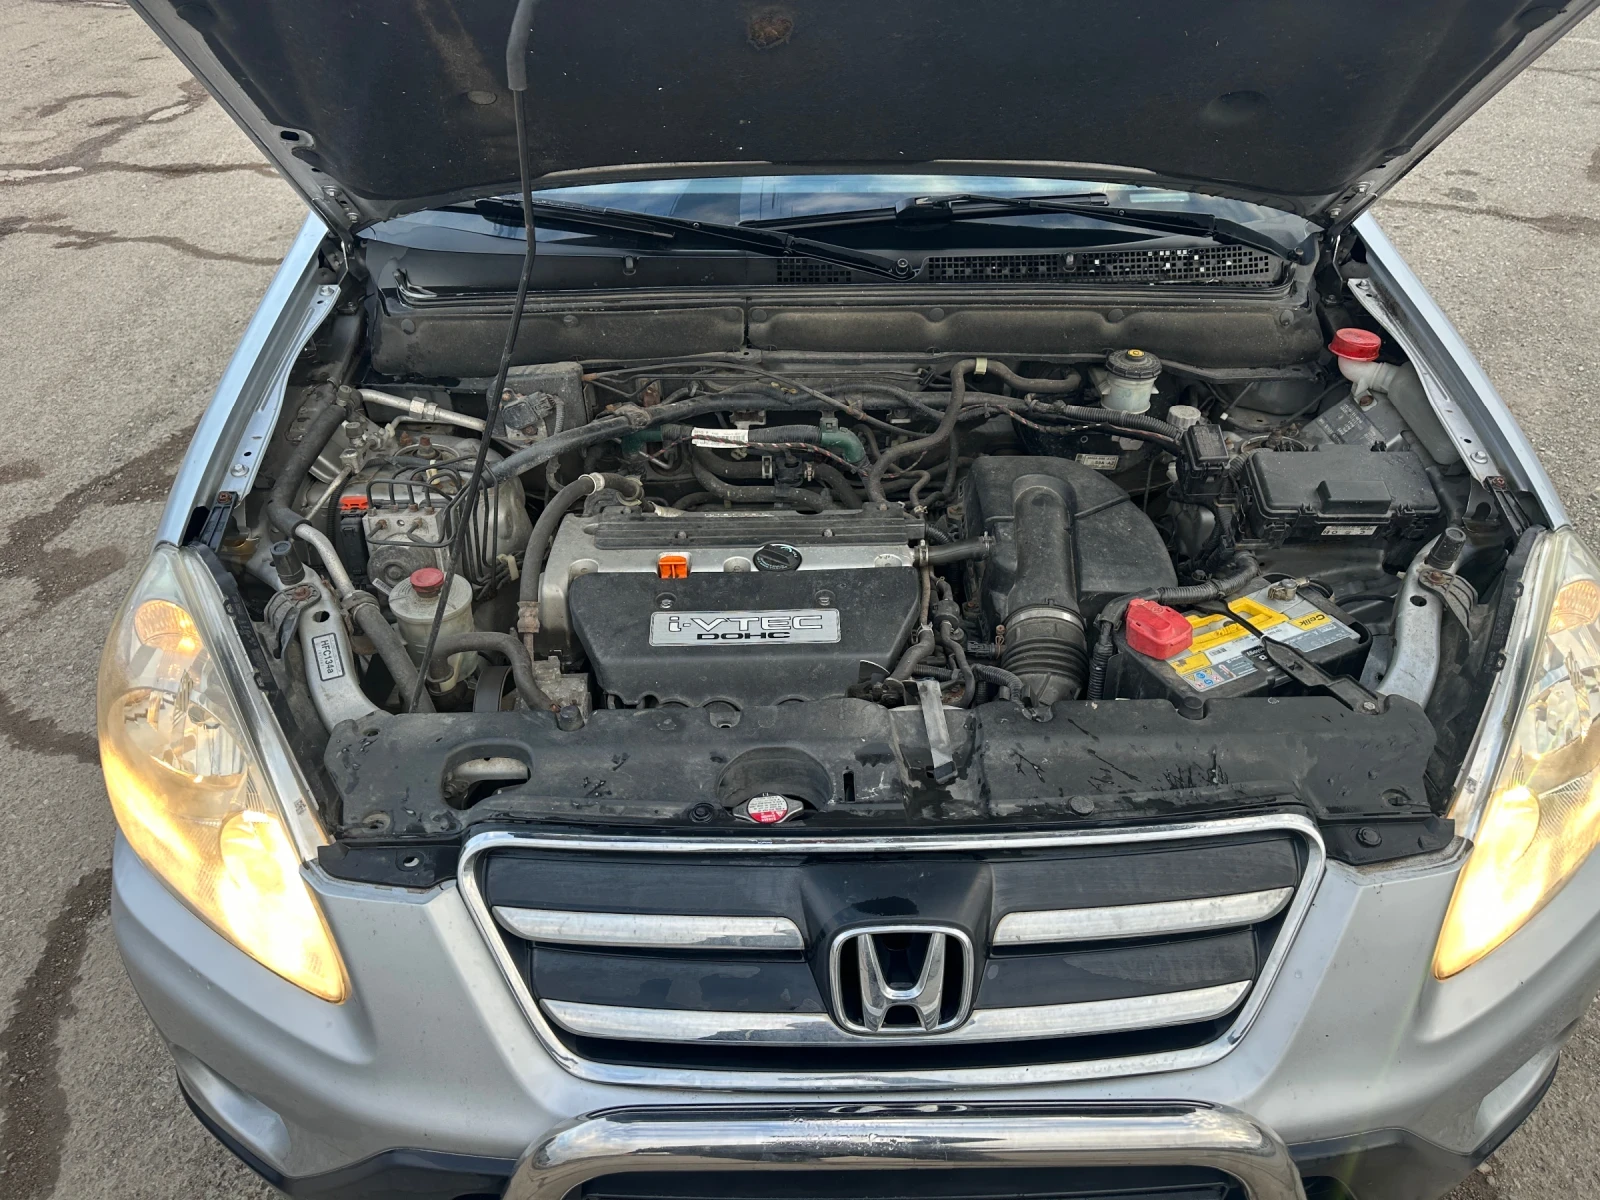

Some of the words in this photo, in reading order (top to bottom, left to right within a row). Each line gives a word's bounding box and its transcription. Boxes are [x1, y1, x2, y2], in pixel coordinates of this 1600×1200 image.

[669, 615, 823, 632] i-VTEC
[697, 631, 791, 640] DOHC
[320, 639, 335, 674] HFC134a
